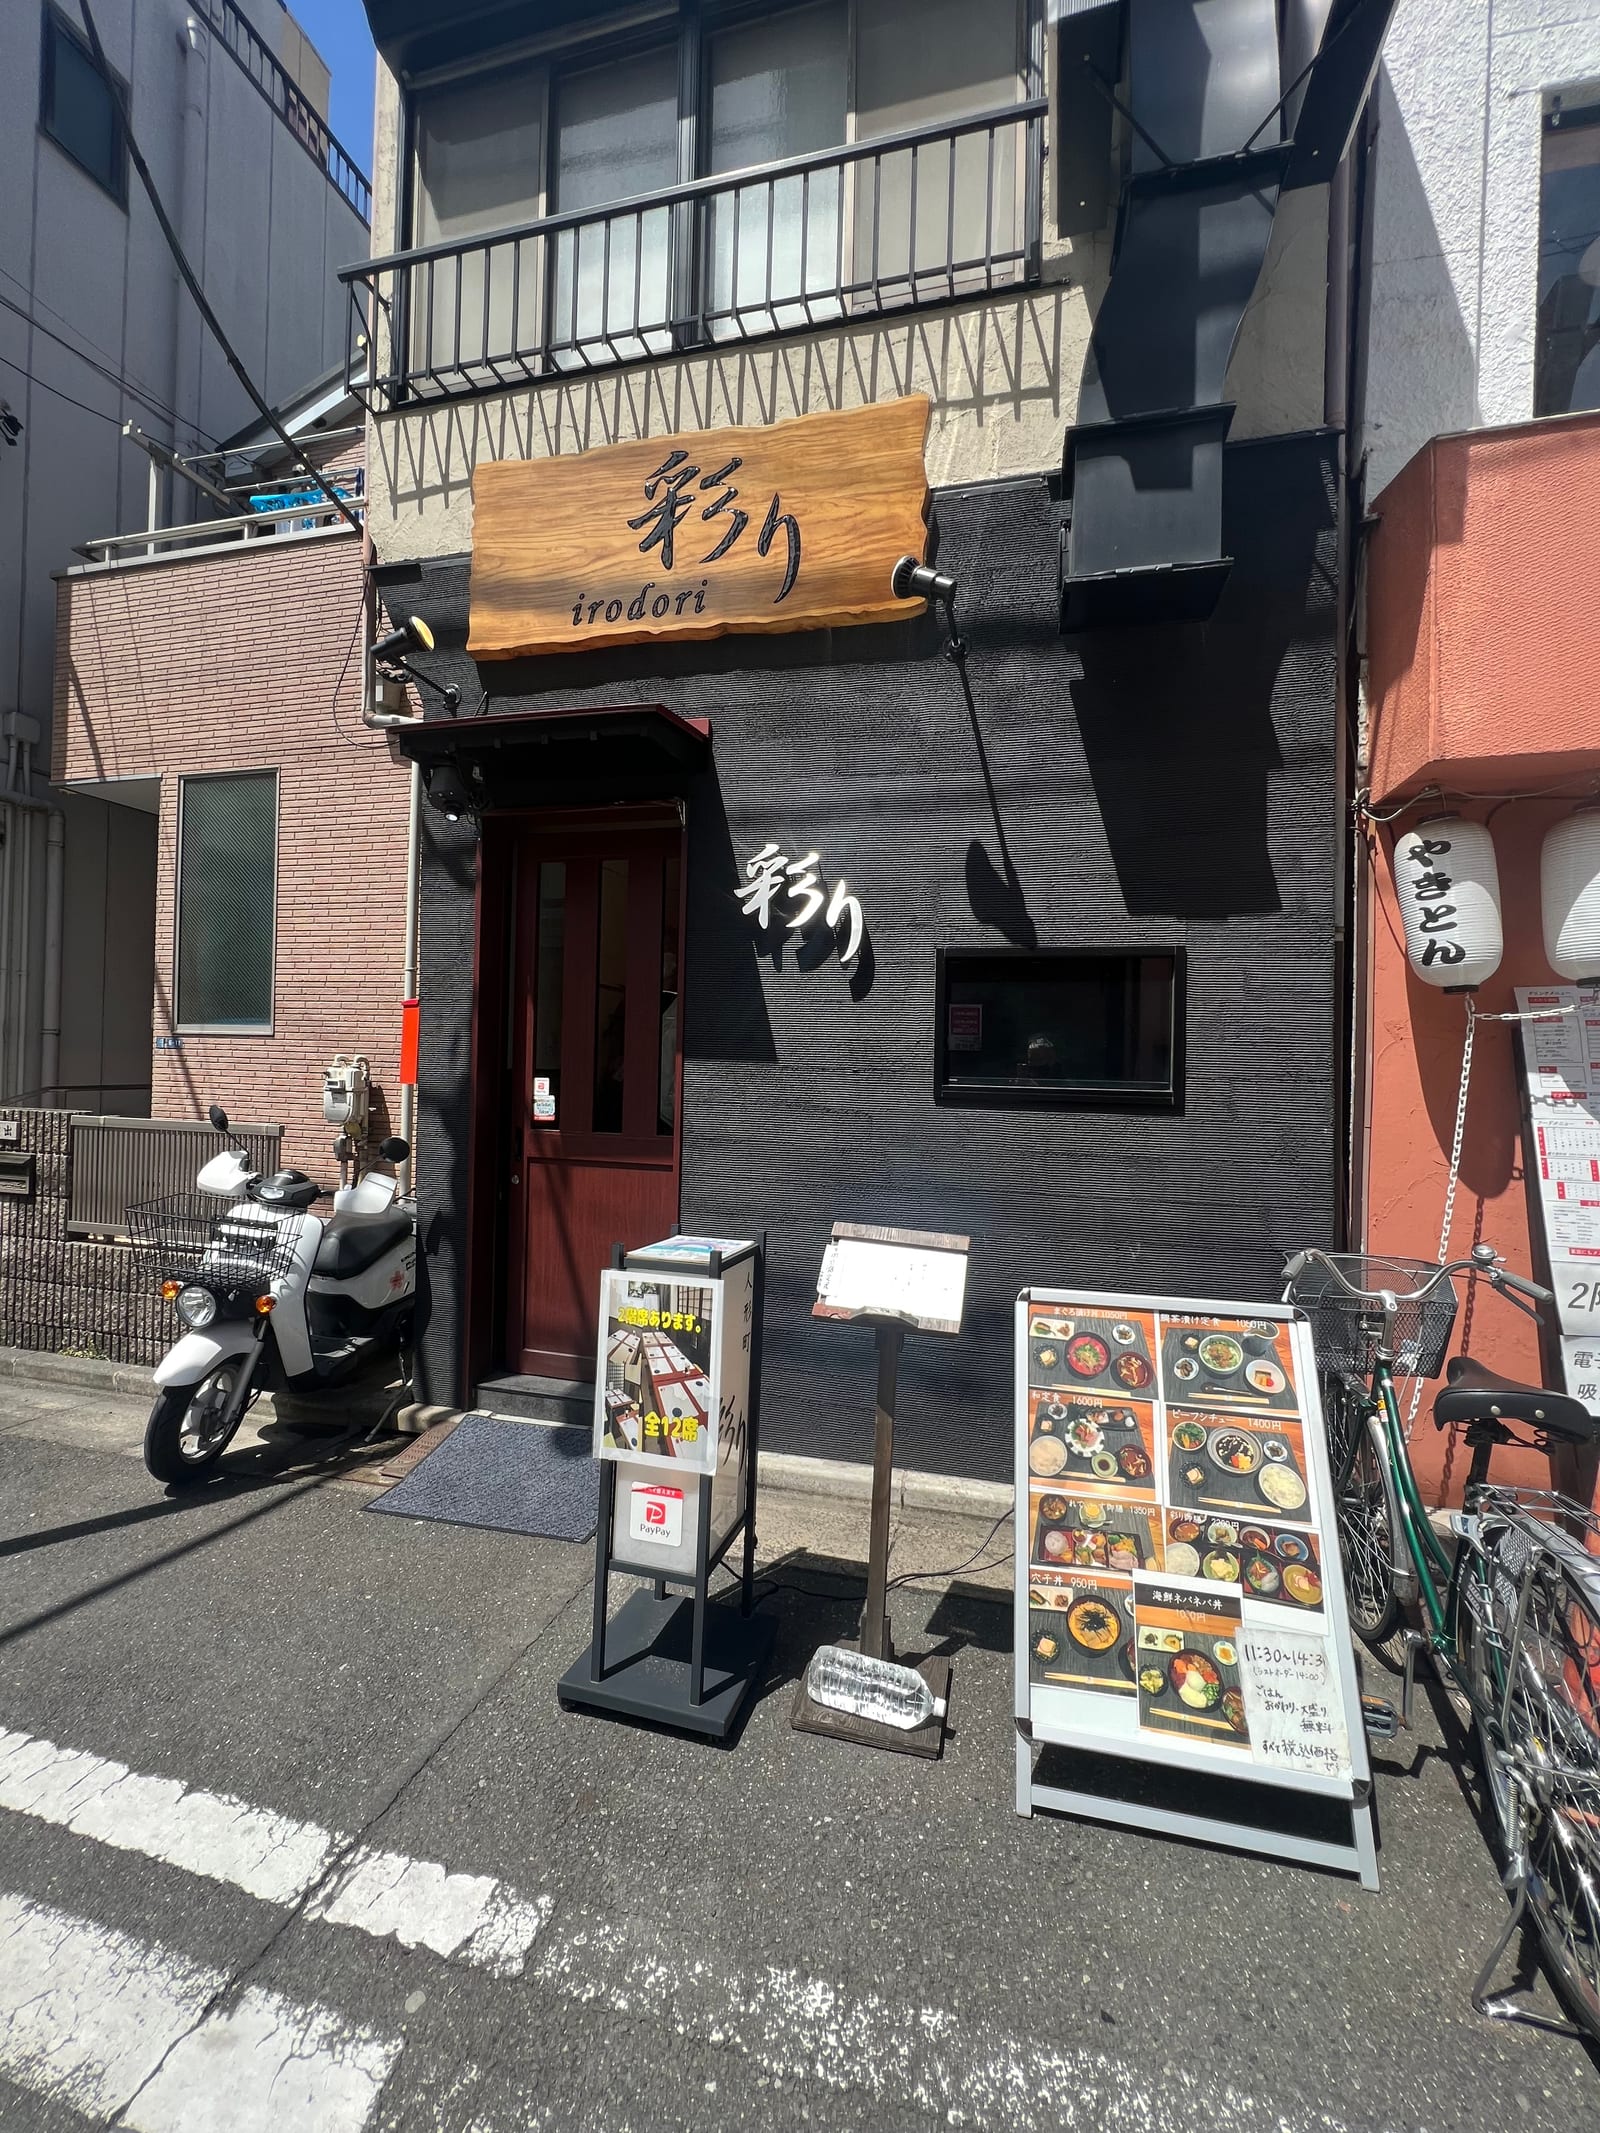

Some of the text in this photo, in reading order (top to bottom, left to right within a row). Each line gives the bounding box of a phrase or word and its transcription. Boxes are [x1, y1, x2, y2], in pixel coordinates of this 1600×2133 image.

[627, 450, 802, 604] 彩り
[572, 579, 708, 627] irodori
[733, 843, 863, 963] 彩り
[1407, 839, 1466, 966] やきとん
[617, 1306, 702, 1334] 2階席あります。
[743, 1272, 753, 1352] 人形町
[1032, 1391, 1103, 1408] 和定食 1600円
[1578, 1384, 1600, 1401] 吸
[643, 1411, 699, 1442] 全12席
[1172, 1409, 1281, 1431] ビーフシチュー 1400円
[1129, 1505, 1155, 1516] 1350円
[640, 1523, 671, 1538] PayPay
[1070, 1577, 1097, 1590] 950円
[1256, 1685, 1283, 1698] ごはん
[1300, 1717, 1332, 1734] 無料
